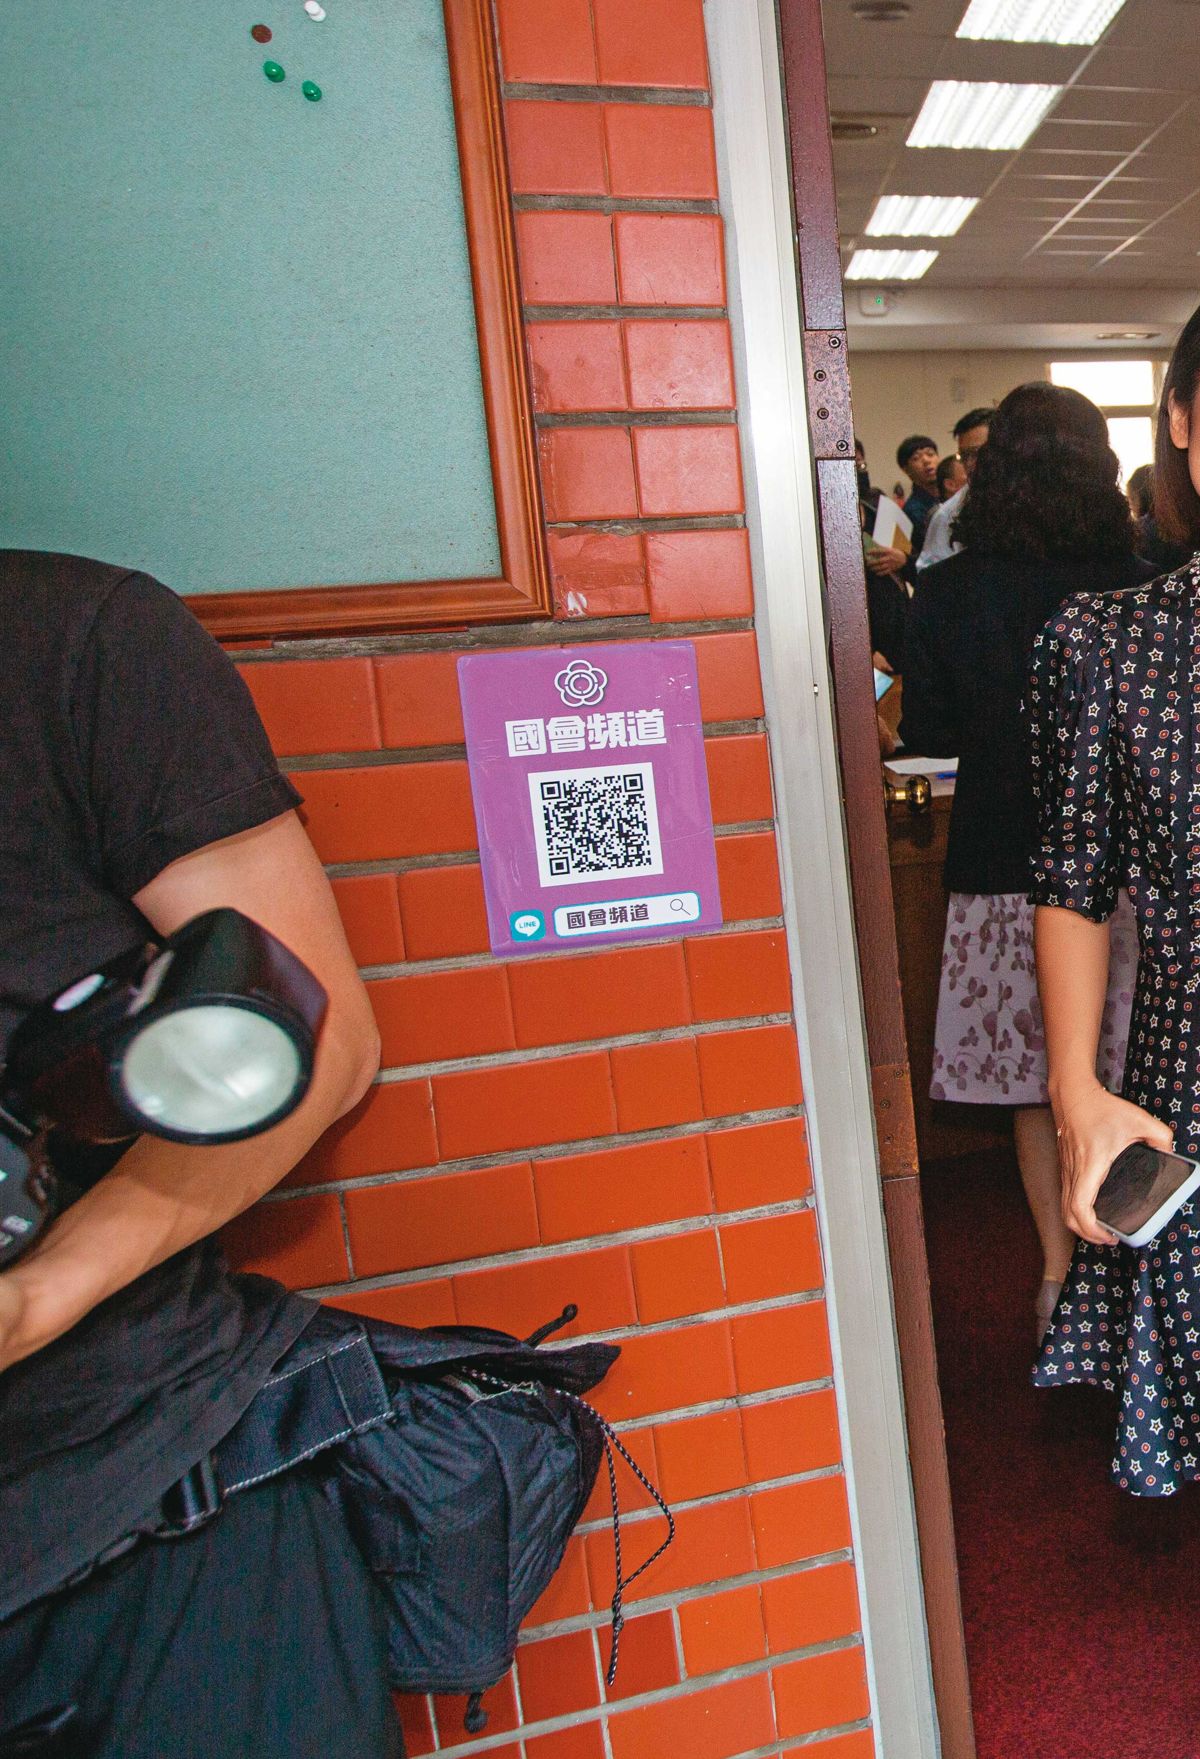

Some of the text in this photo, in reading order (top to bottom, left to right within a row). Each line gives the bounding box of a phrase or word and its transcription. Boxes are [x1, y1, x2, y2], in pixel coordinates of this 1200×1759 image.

[504, 708, 667, 757] 國會頻道
[518, 920, 537, 929] LINE
[566, 903, 650, 930] 國會頻道
